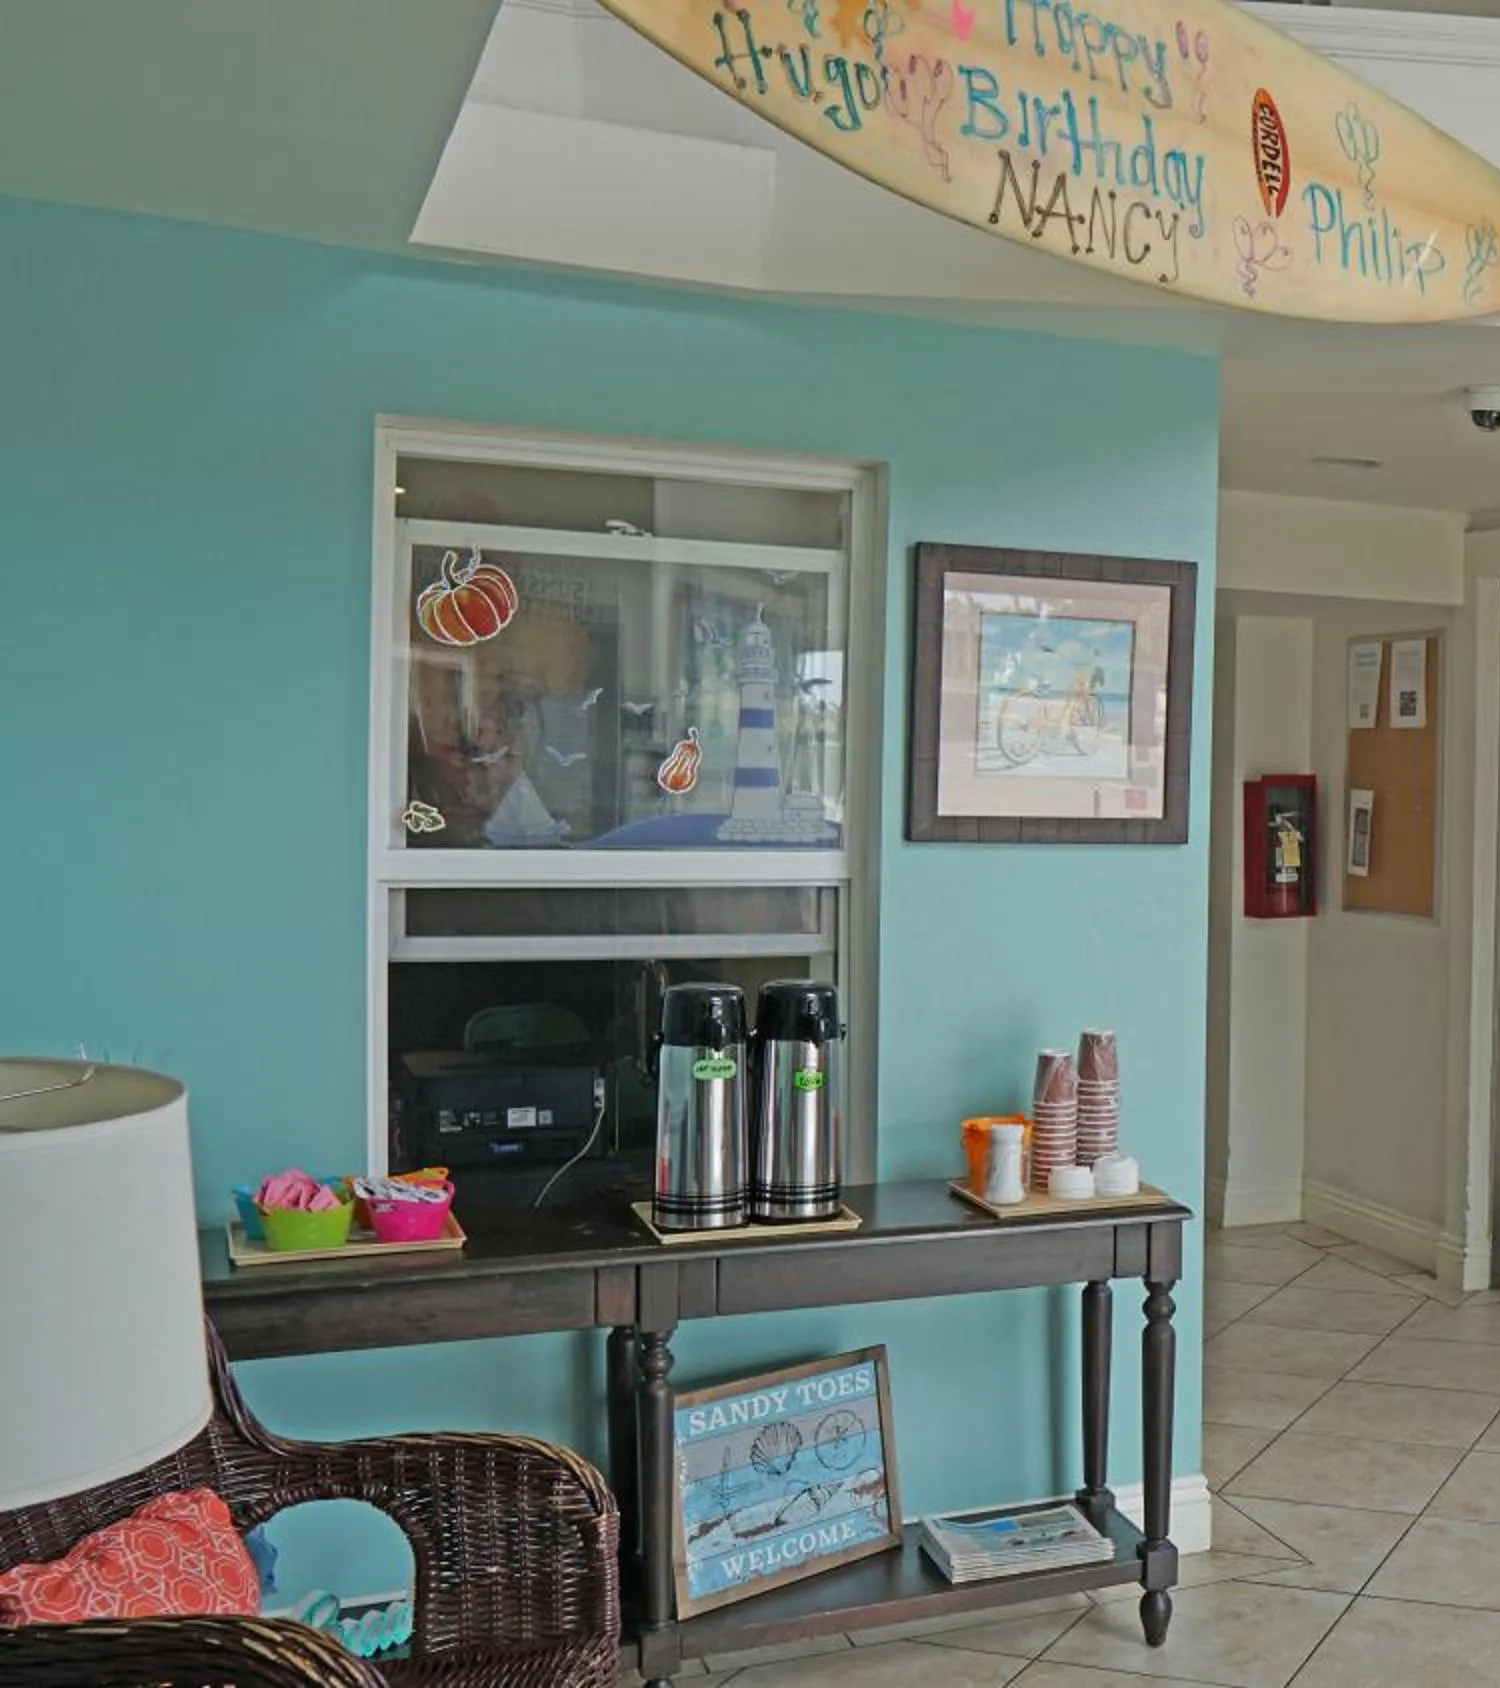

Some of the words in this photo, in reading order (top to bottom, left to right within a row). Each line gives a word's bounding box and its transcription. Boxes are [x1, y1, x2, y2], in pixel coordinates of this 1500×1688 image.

[713, 8, 882, 131] Hugo
[1004, 0, 1173, 108] Happy
[957, 66, 1205, 239] Birthday
[988, 150, 1184, 283] NANCY
[1303, 183, 1446, 297] Philip
[688, 1388, 789, 1436] SANDY
[796, 1369, 872, 1406] TOES
[720, 1519, 857, 1580] WELCOME
